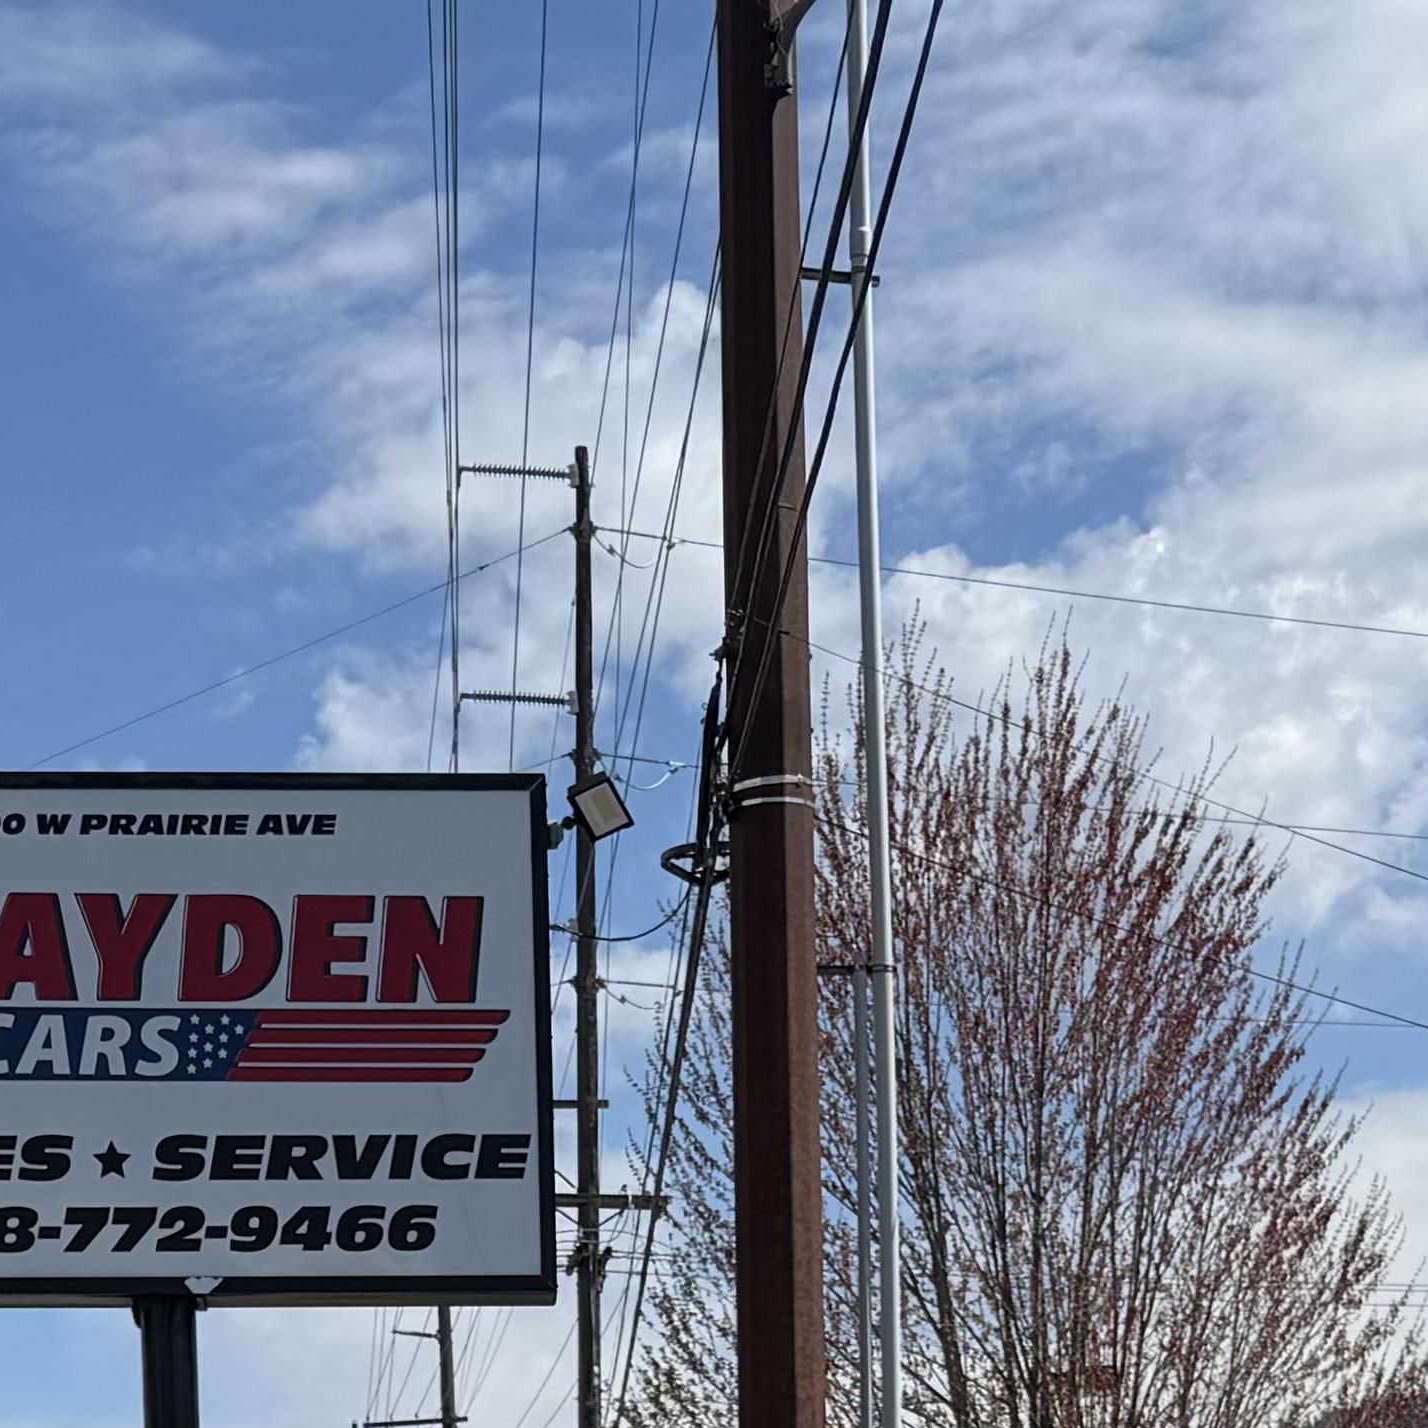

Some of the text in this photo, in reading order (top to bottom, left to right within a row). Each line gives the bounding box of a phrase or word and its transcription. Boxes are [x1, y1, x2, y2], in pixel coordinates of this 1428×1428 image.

[36, 814, 73, 835] W
[80, 814, 249, 836] PRAIRIE
[256, 814, 337, 836] AVE
[152, 1133, 532, 1181] SERVICE
